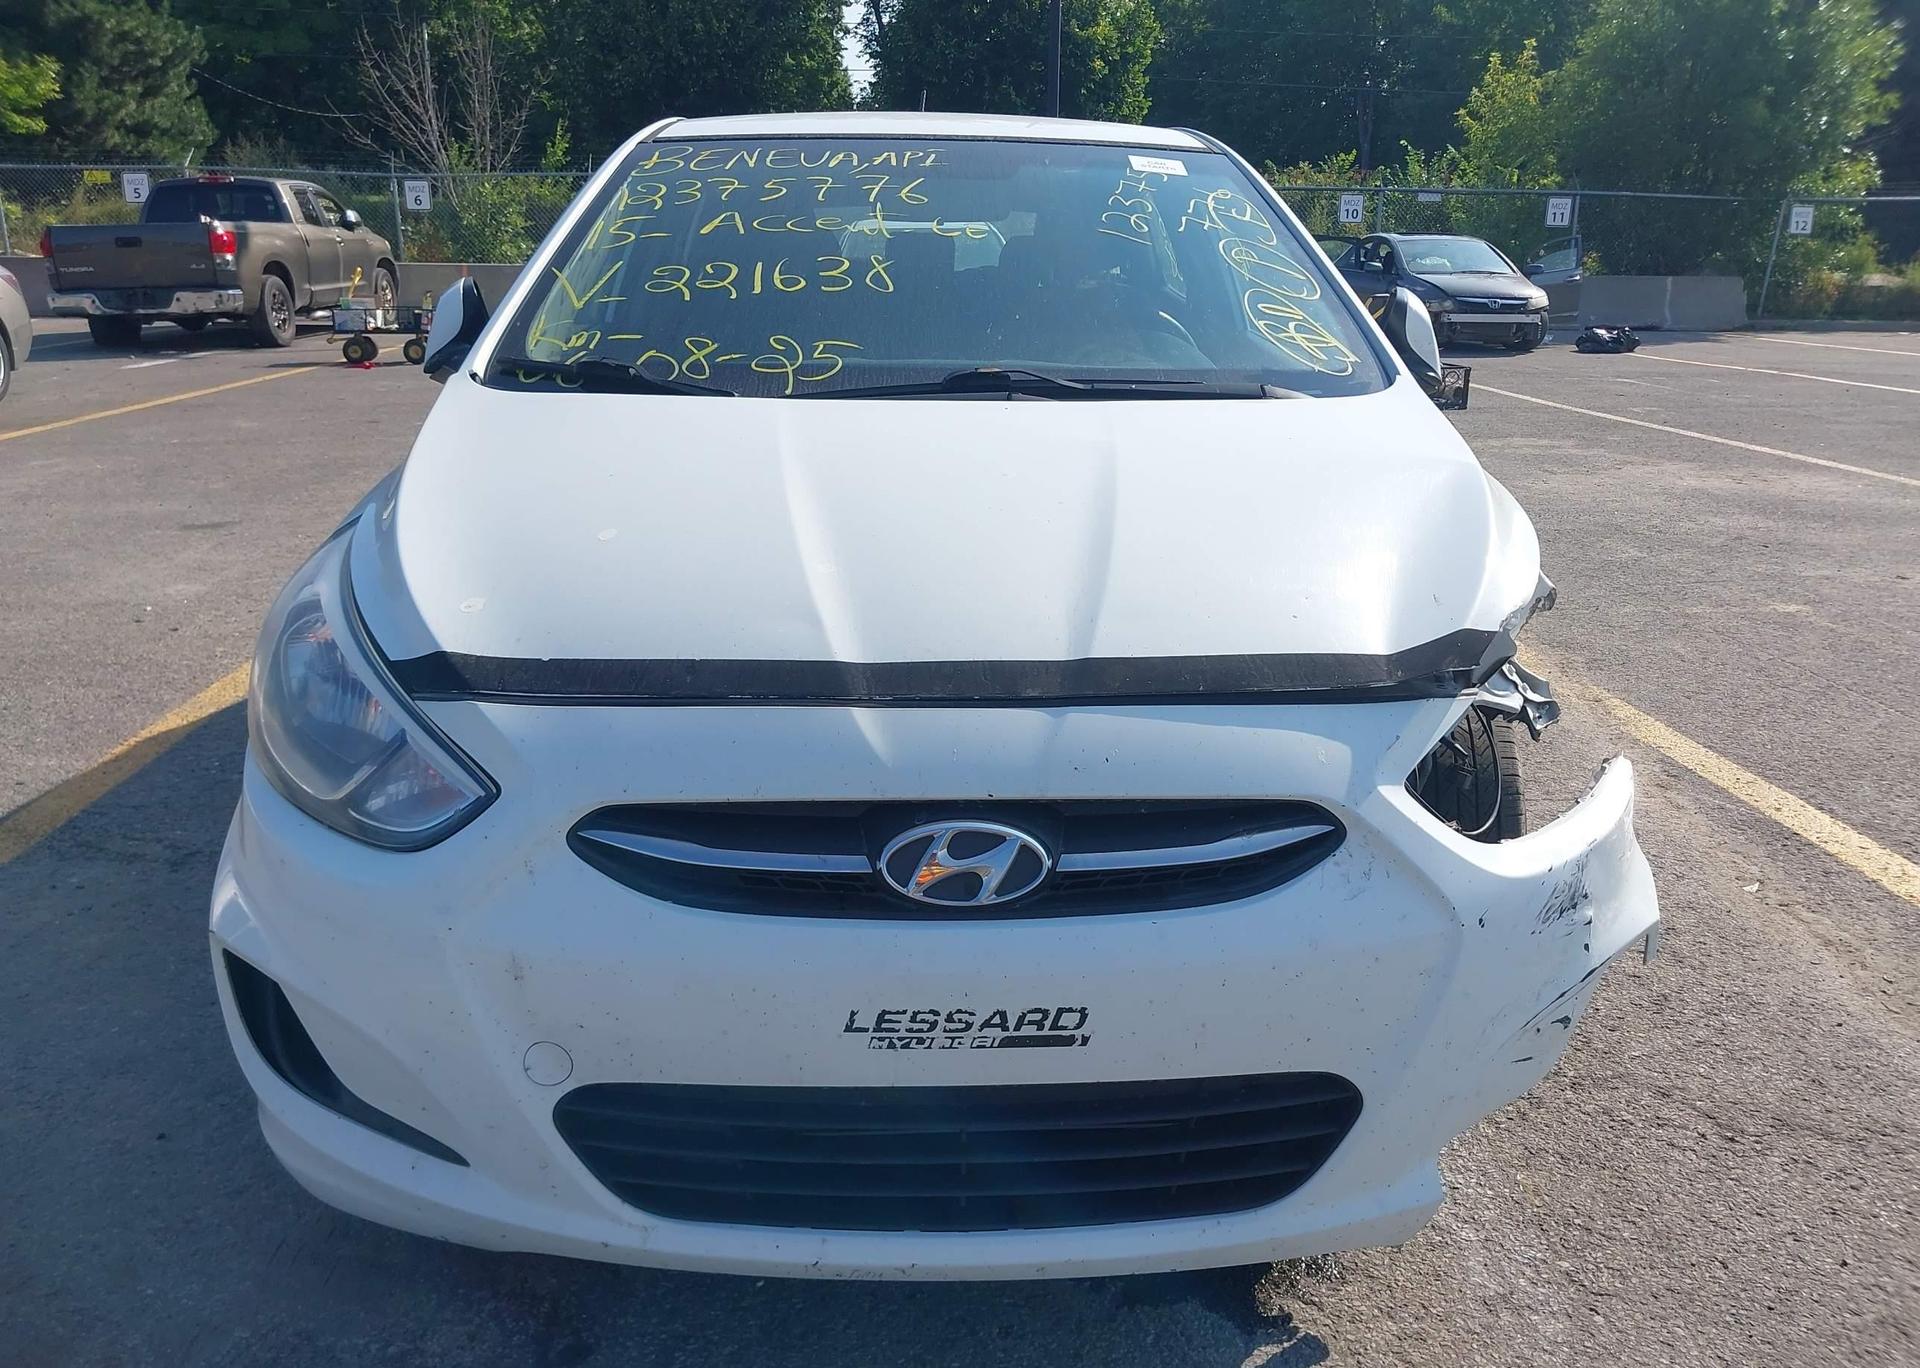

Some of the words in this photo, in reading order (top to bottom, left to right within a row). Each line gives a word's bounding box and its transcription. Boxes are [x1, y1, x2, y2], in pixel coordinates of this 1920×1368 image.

[133, 187, 142, 199] 5
[414, 194, 423, 206] 6
[1343, 199, 1360, 207] MDZ
[1551, 202, 1568, 210] MDZ
[1344, 208, 1359, 219] 10
[1551, 211, 1565, 223] 11
[1794, 220, 1808, 231] 12
[644, 254, 895, 301] 221638
[842, 1006, 1091, 1034] LESSARD
